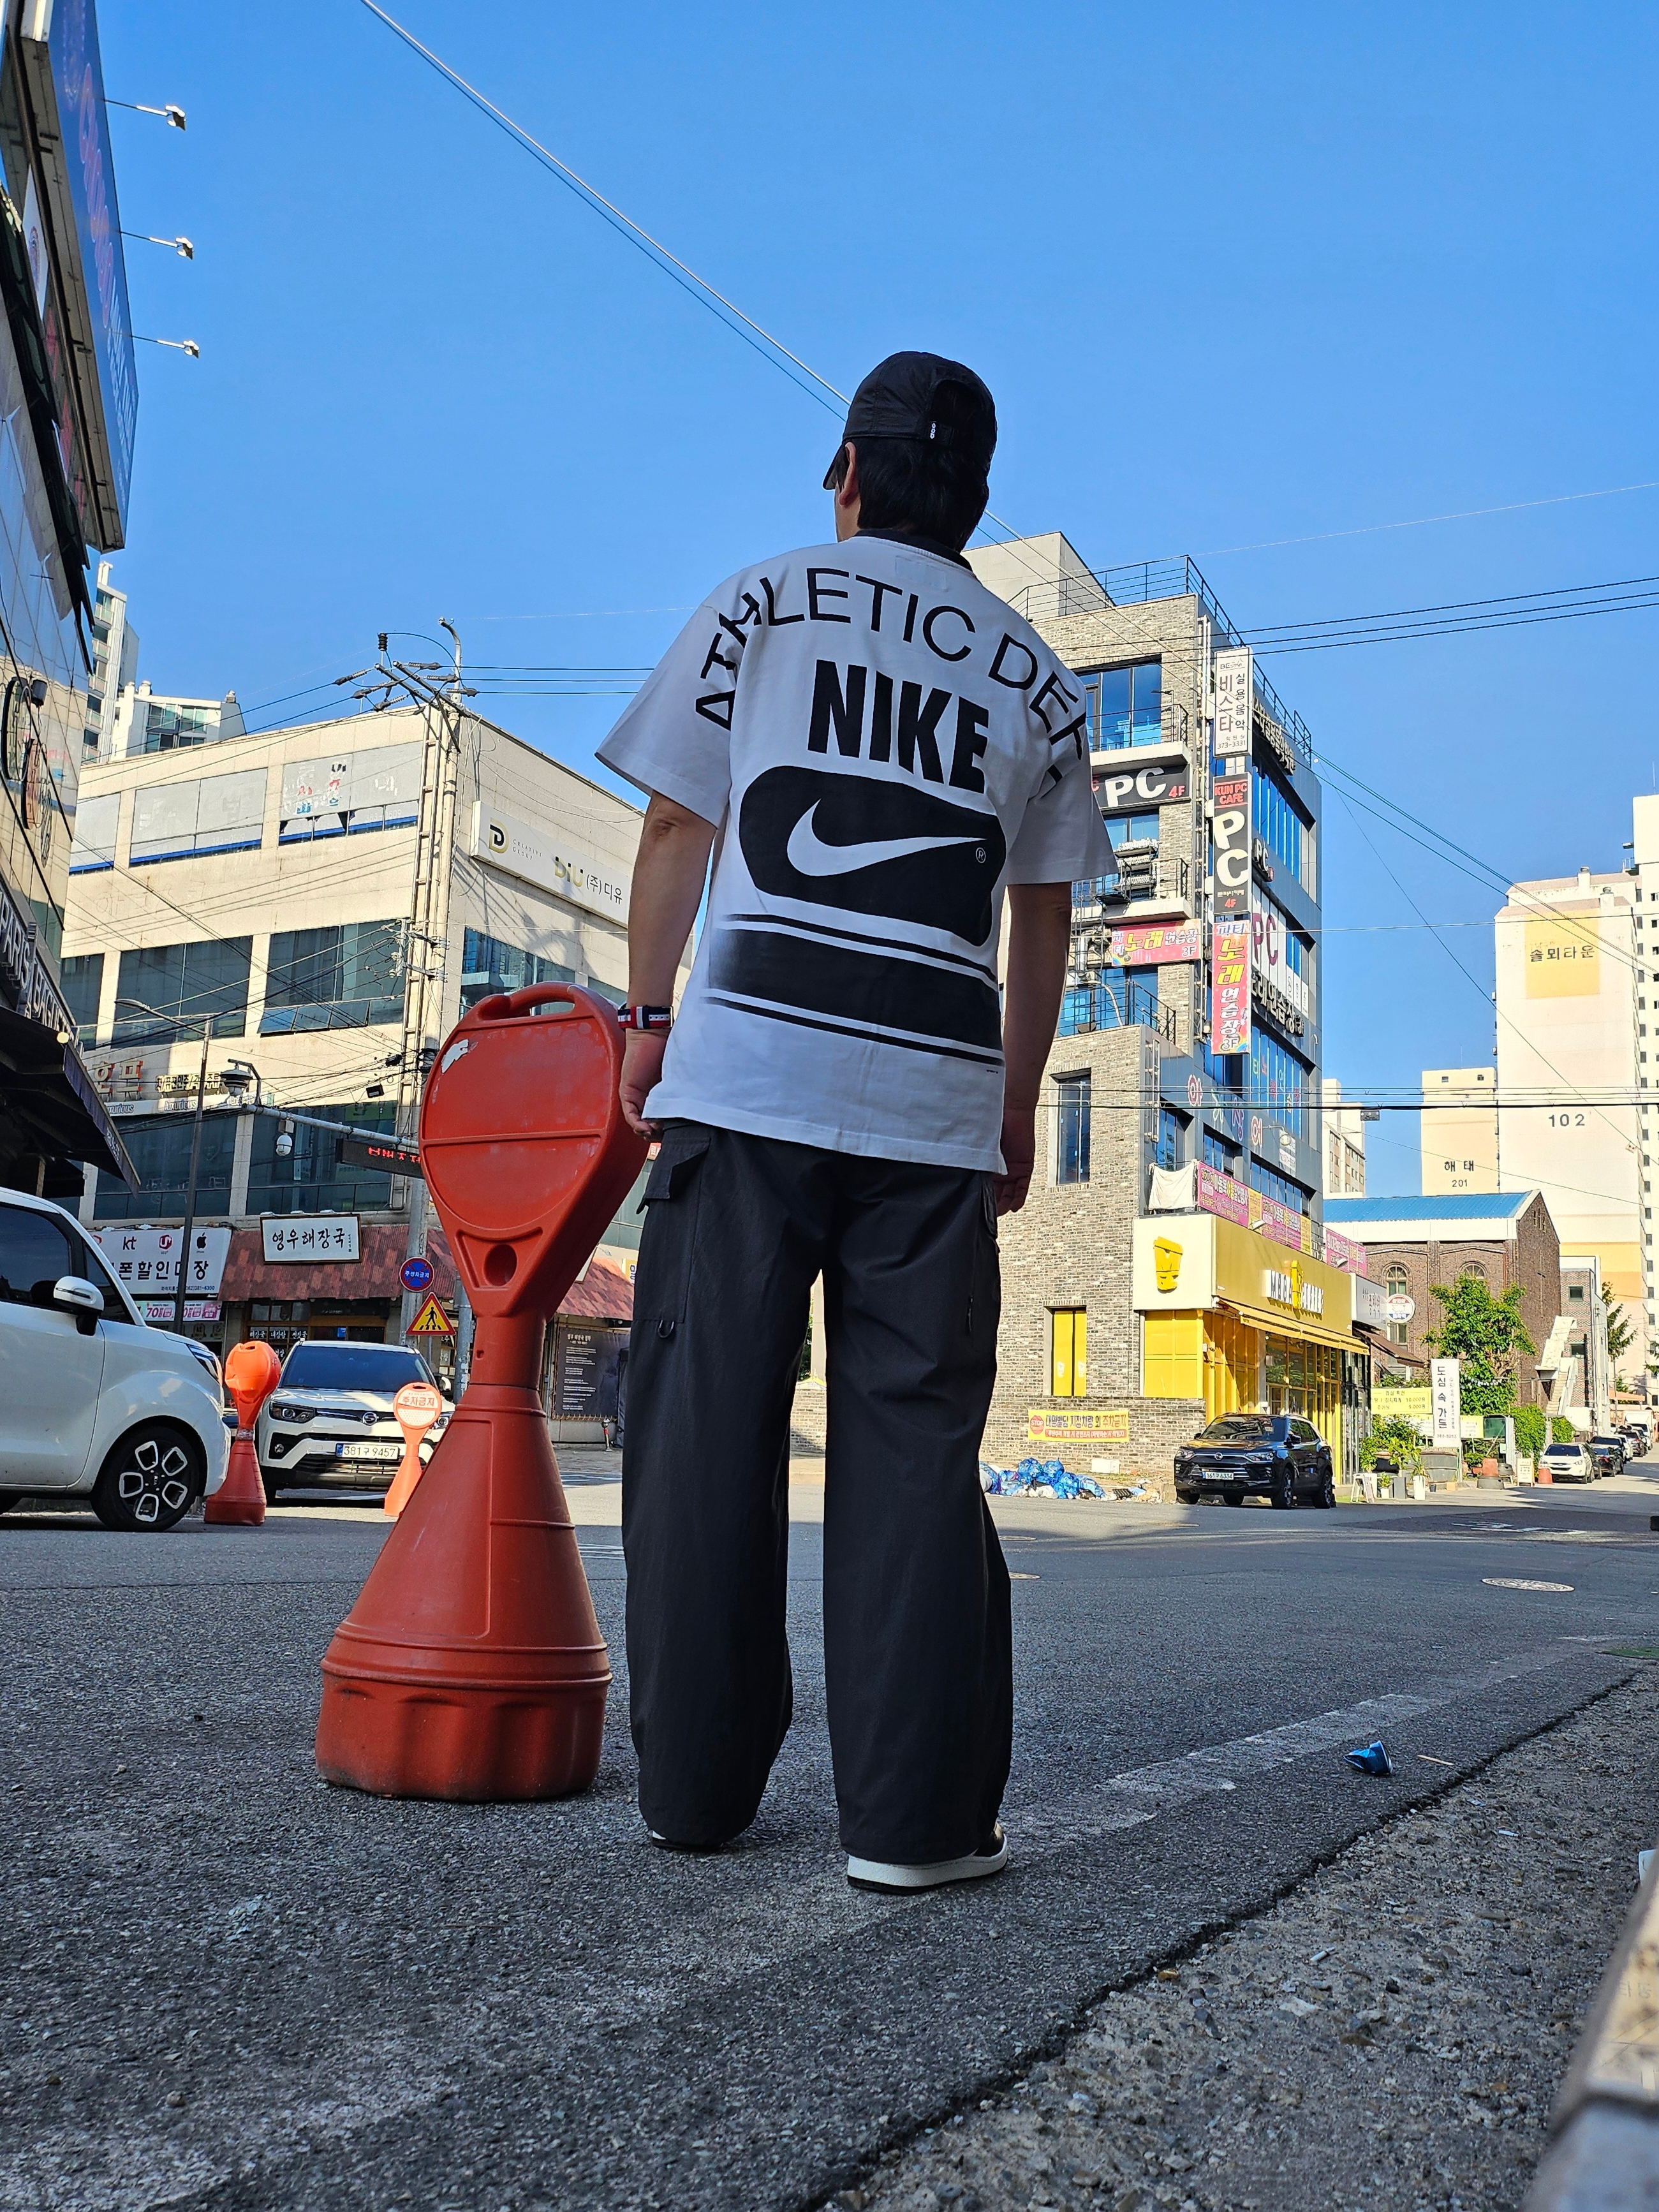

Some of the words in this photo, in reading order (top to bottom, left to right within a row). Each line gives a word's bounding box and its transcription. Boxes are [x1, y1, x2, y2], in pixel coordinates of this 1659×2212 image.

[695, 568, 977, 731] ATHLETIC
[1219, 674, 1234, 733] 비스타
[1235, 673, 1246, 731] 실용음악
[807, 659, 989, 794] NIKE
[1217, 741, 1246, 749] 373-3331
[1105, 767, 1167, 807] PC
[1169, 785, 1186, 798] 4F
[1214, 785, 1233, 796] KUN
[1234, 782, 1248, 793] PC
[1219, 793, 1244, 805] CAFE
[512, 846, 533, 860] GROUP
[513, 839, 542, 857] CREATIVE
[1214, 810, 1249, 887] PC
[1253, 837, 1269, 873] PC
[586, 873, 623, 905] (주)디유
[1225, 898, 1236, 908] 4F
[1216, 923, 1245, 937] 파티
[1112, 930, 1124, 955] 파티
[1126, 929, 1165, 952] 노래
[1165, 929, 1198, 945] 연습장
[1252, 913, 1279, 966] PC
[1182, 945, 1197, 958] 3F
[1530, 945, 1595, 962] 솔뫼타운
[1216, 939, 1246, 985] 노래
[1220, 987, 1241, 1036] 연습장
[1223, 1038, 1239, 1051] 3F
[164, 1099, 197, 1112] luxurious
[1549, 1114, 1586, 1128] 102
[1444, 1160, 1474, 1172] 해태
[1452, 1179, 1468, 1187] 201
[122, 1236, 137, 1251] kt
[272, 1228, 345, 1251] 영우해장국
[112, 1260, 209, 1280] 폰할인장
[1437, 1366, 1446, 1387] 도심
[402, 1396, 435, 1407] 주차금지
[1438, 1392, 1447, 1403] 속
[1070, 1415, 1093, 1429] 지정차량
[1095, 1415, 1102, 1428] 외
[1102, 1414, 1126, 1428] 주차금지
[1438, 1408, 1447, 1429] 가든
[372, 1447, 396, 1457] 9457
